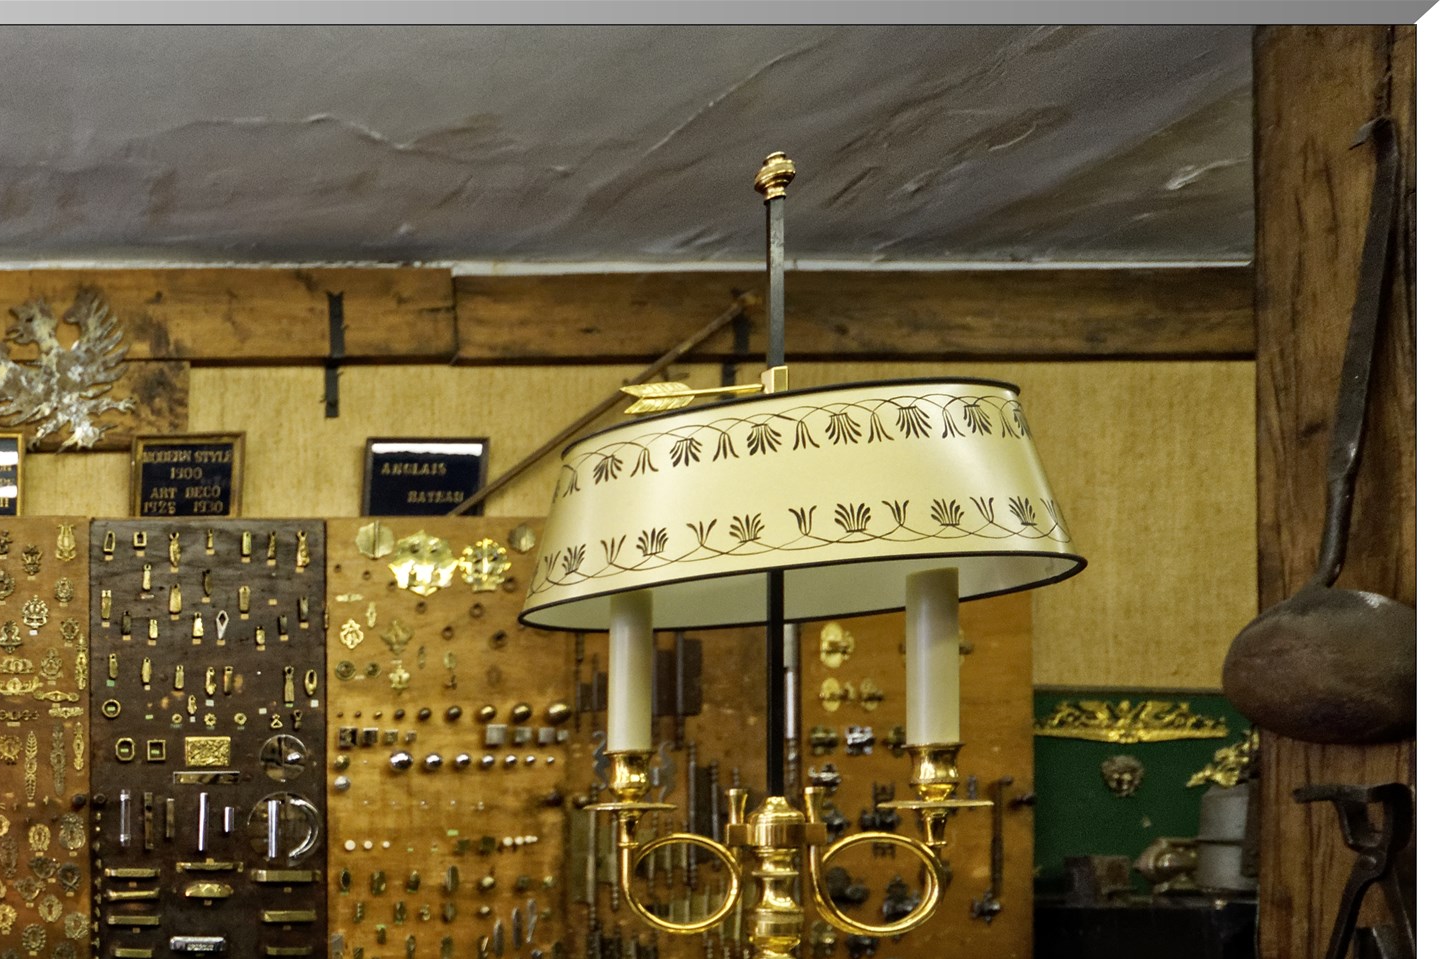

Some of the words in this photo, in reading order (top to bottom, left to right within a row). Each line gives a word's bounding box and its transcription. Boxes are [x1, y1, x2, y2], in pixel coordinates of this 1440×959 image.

[142, 450, 192, 463] MODERN
[194, 449, 232, 463] STYLE
[170, 466, 203, 480] 1900
[380, 462, 447, 475] ANGLAIS
[150, 487, 177, 499] ART
[185, 485, 221, 499] DECO
[407, 491, 464, 503] BATEAU
[193, 500, 224, 513] 1930
